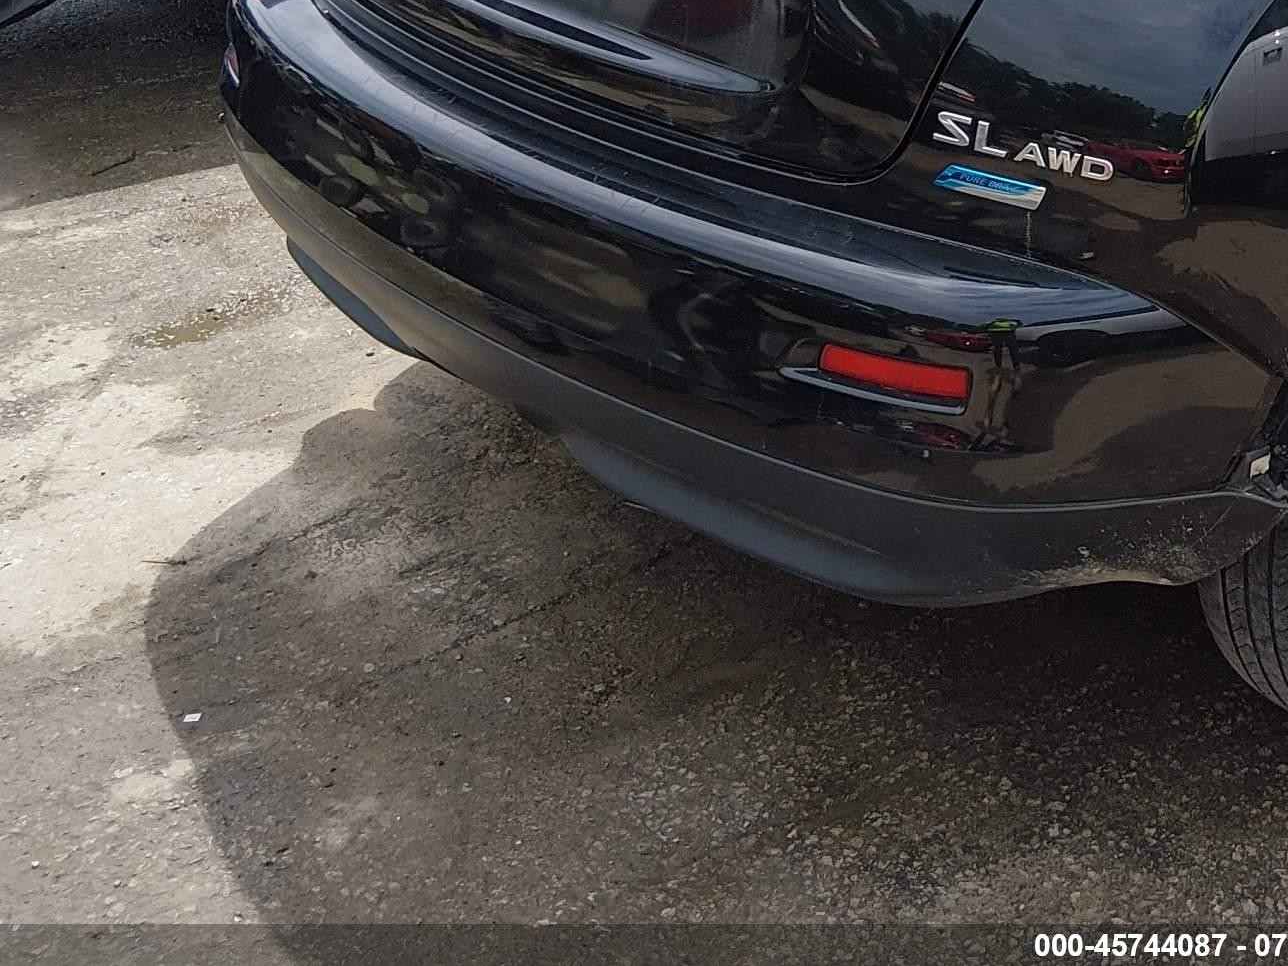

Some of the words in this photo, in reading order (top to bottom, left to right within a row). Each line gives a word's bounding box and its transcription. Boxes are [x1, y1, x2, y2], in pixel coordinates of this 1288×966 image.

[932, 110, 1008, 158] SL
[1013, 142, 1115, 182] AWD
[959, 173, 988, 186] PURE
